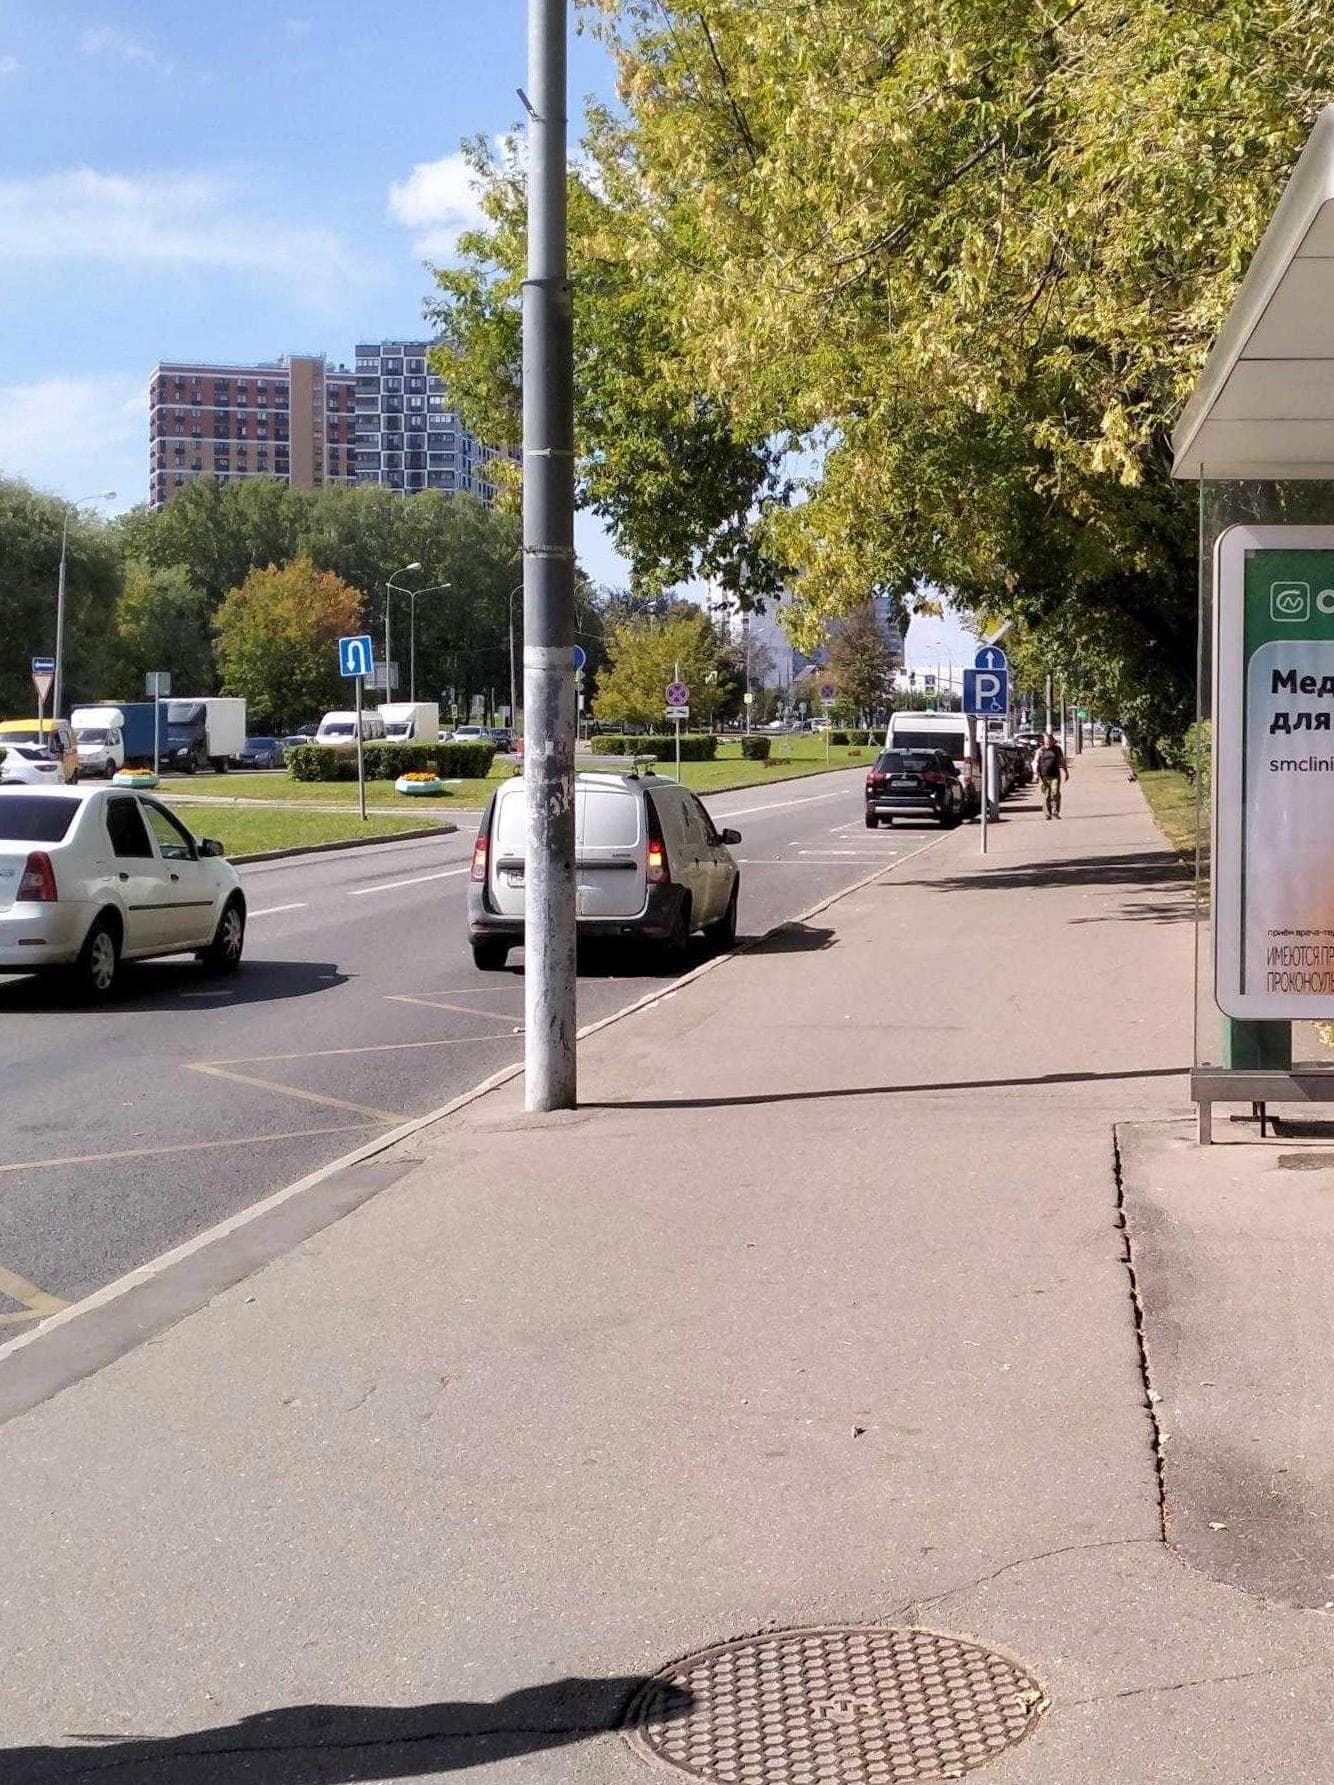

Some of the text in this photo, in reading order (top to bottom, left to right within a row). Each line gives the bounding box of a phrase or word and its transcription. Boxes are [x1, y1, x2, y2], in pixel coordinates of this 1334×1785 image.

[975, 673, 1001, 710] P
[1269, 711, 1331, 735] для
[1266, 945, 1320, 966] ИМЕЮТСЯ
